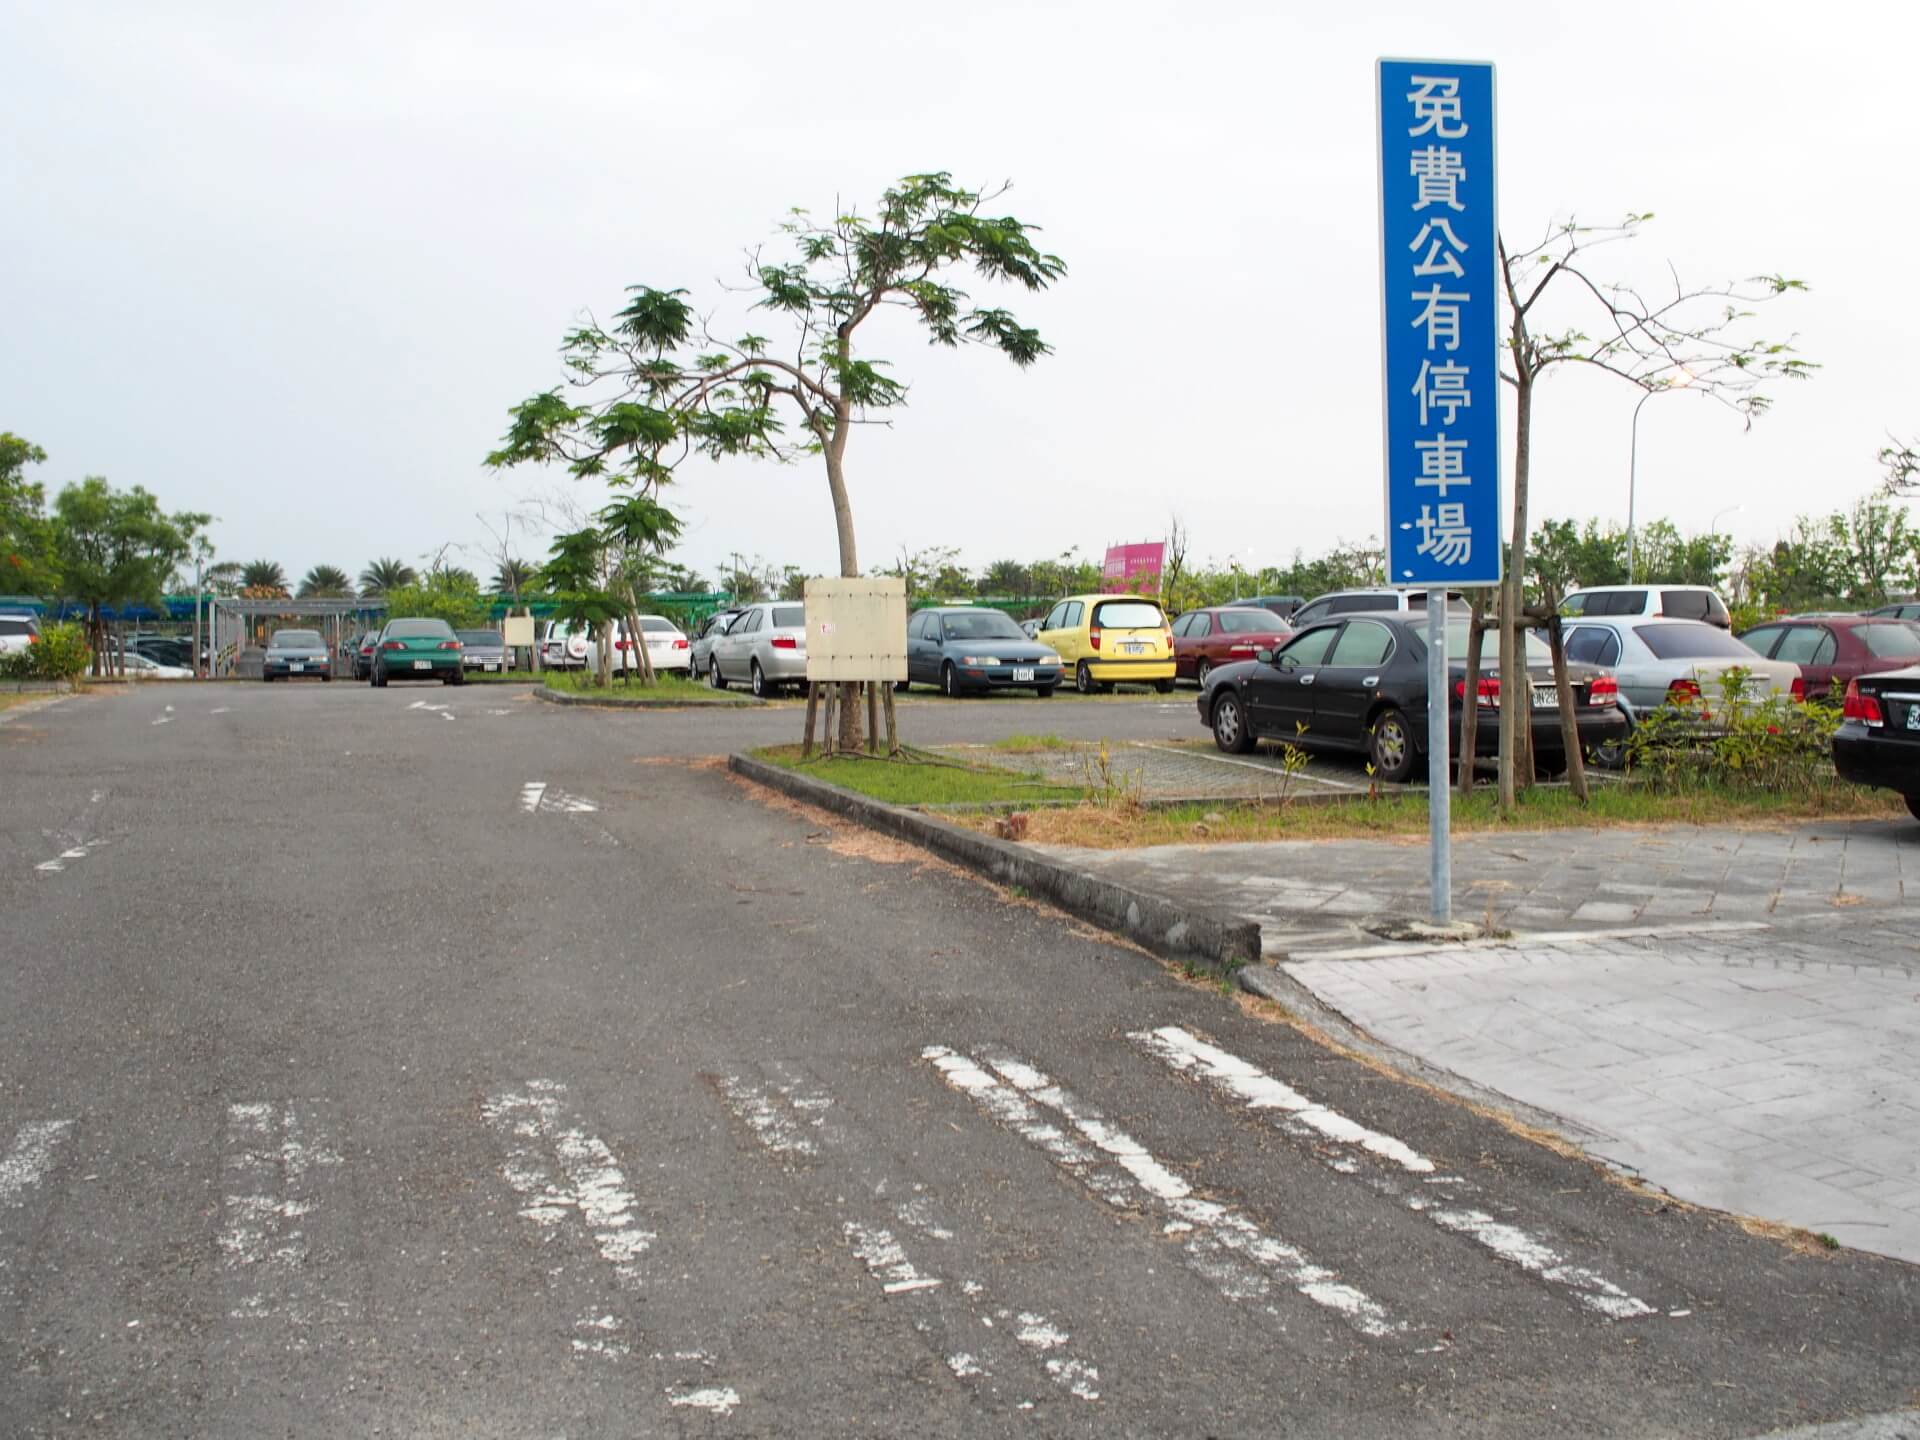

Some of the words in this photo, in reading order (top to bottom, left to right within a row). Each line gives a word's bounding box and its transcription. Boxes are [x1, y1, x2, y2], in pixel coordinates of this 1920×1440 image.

[1407, 75, 1472, 566] 免費公有停車場
